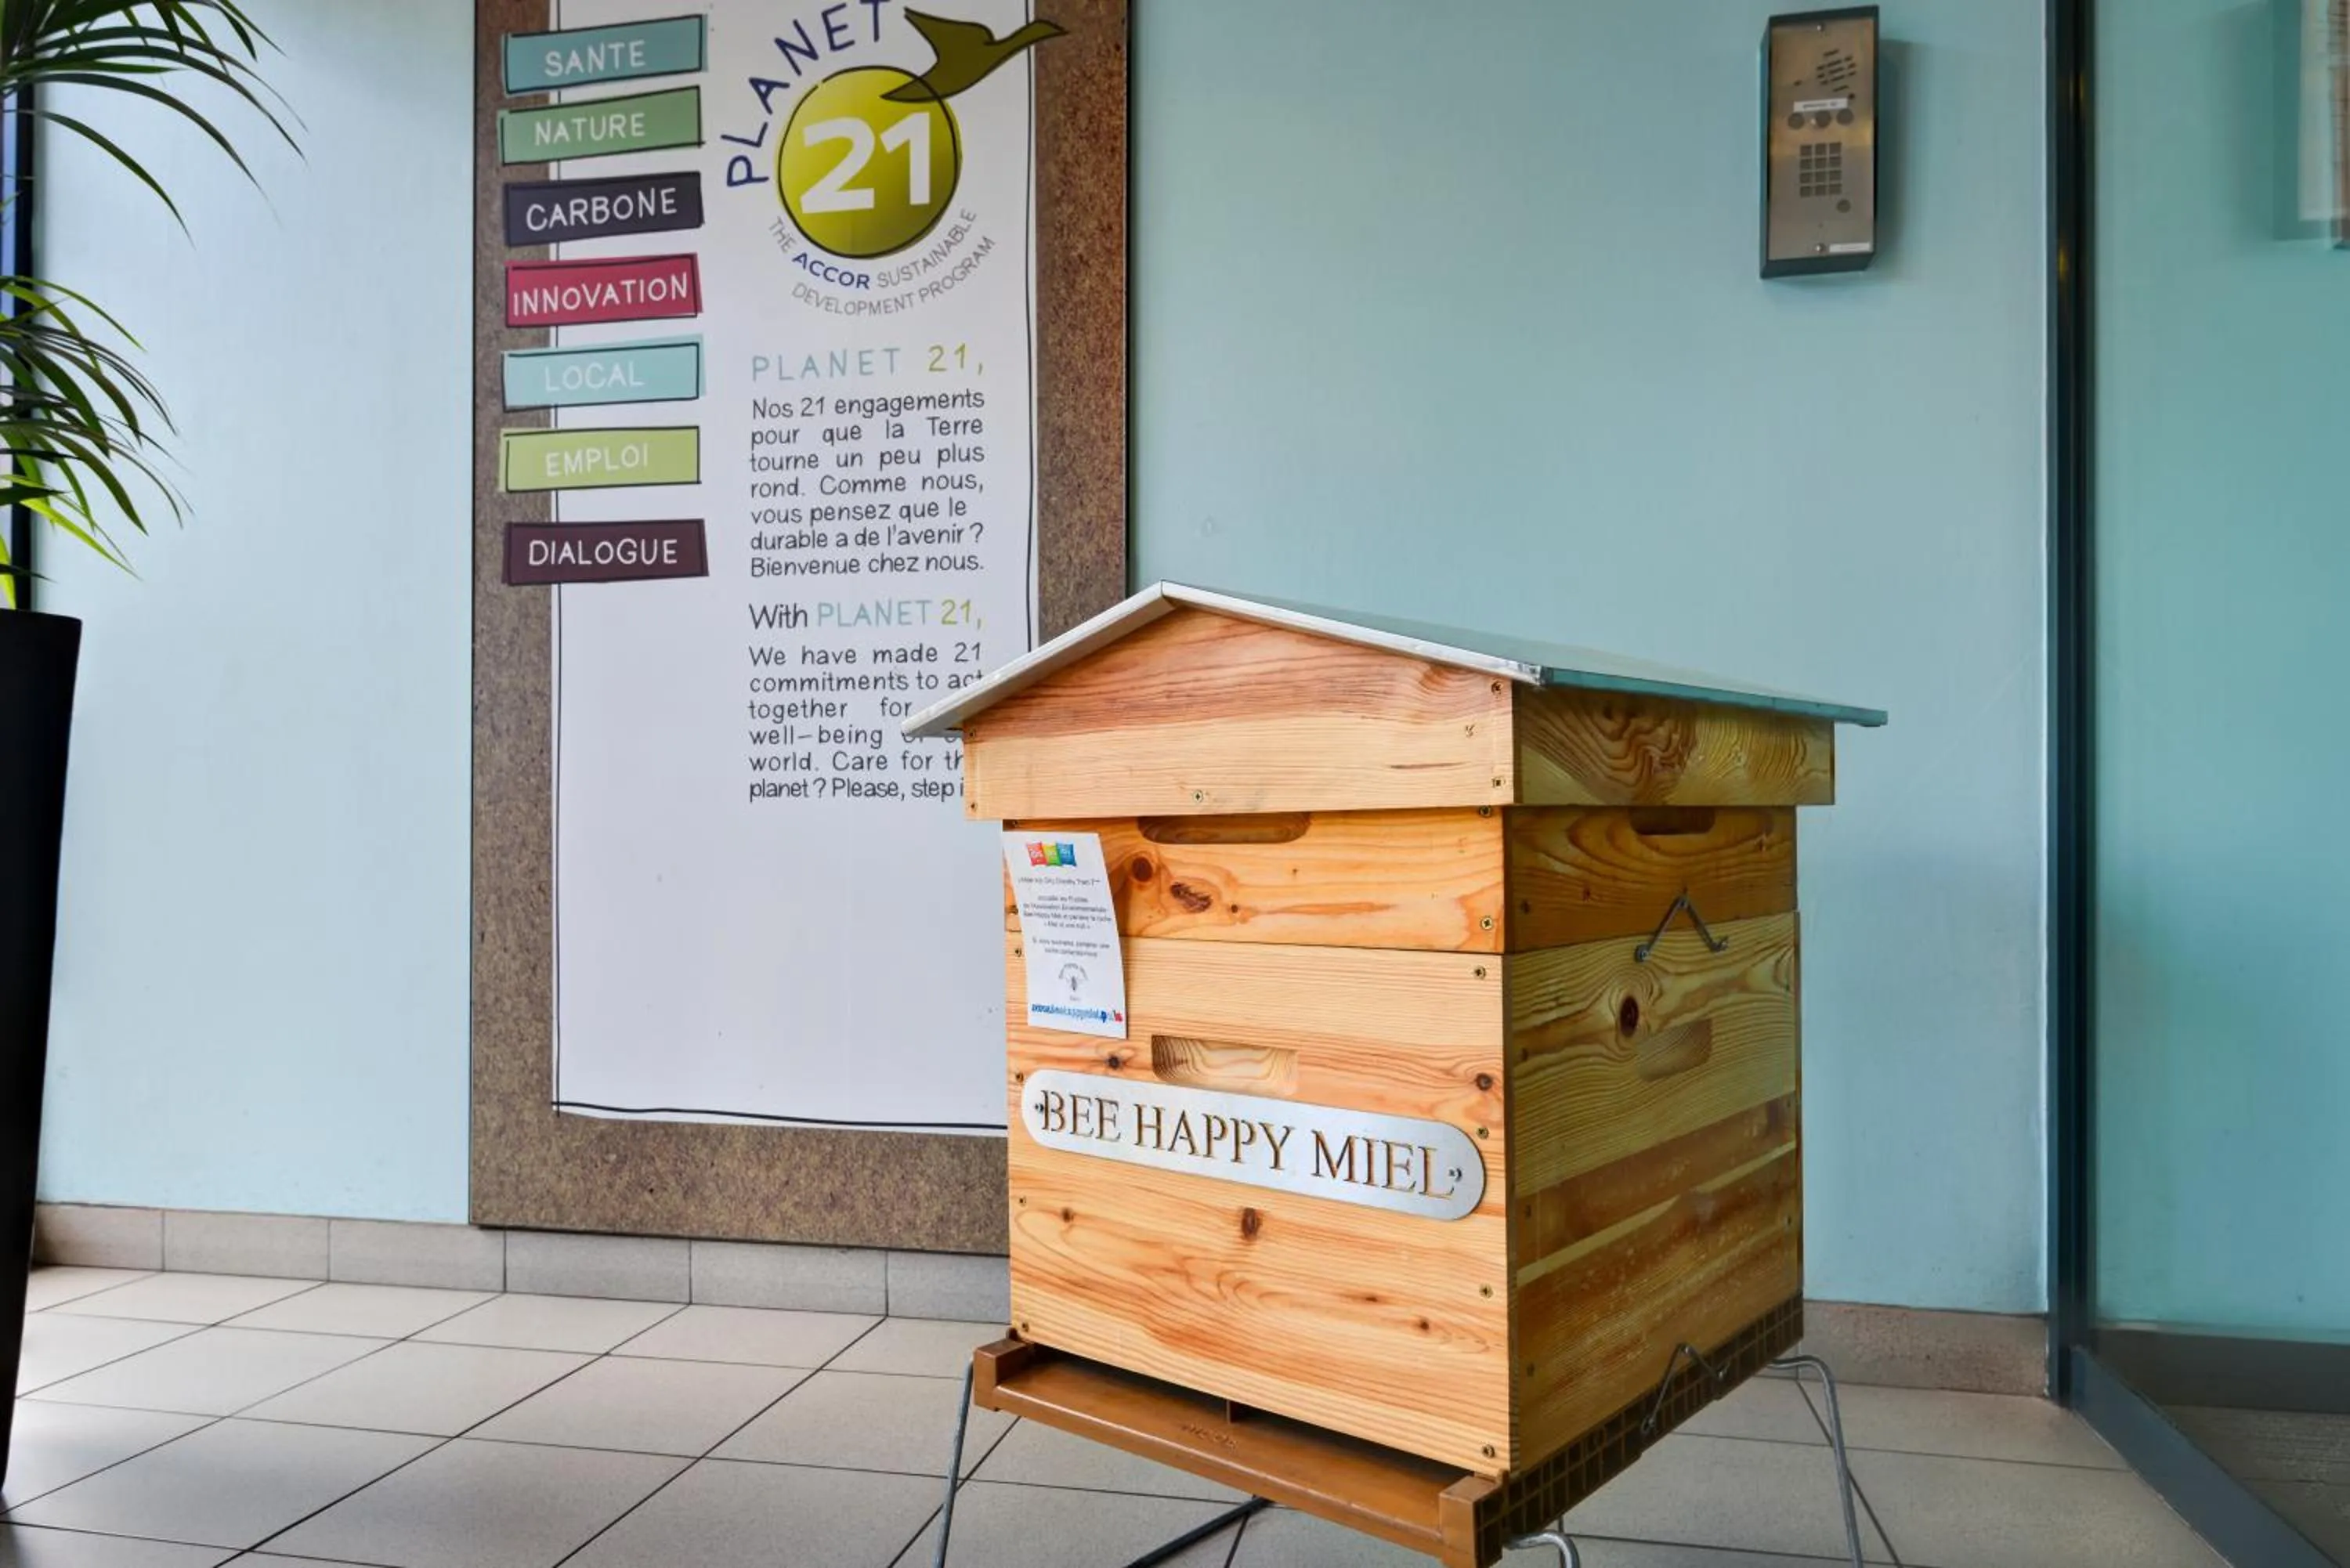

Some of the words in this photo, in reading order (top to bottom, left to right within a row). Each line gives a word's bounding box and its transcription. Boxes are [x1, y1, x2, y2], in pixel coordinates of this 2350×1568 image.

[544, 40, 646, 77] SANTE
[721, 0, 890, 186] PLANET
[534, 113, 645, 146] NATURE
[800, 111, 931, 214] 21
[526, 187, 677, 232] CARBONE
[768, 216, 797, 254] THE
[792, 252, 870, 289] ACCOR
[877, 208, 977, 289] SUSTAINABLE
[791, 281, 915, 316] DEVELOPMENT
[918, 237, 996, 303] PROGRAM
[513, 271, 687, 317] INNOVATION
[544, 361, 645, 392] LOCAL
[752, 348, 900, 381] PLANET
[927, 343, 984, 375] 21,
[752, 397, 794, 420] Nos
[801, 396, 825, 417] 21
[834, 388, 985, 419] engagements
[751, 428, 800, 450] pour
[822, 425, 862, 446] que
[886, 419, 905, 439] la
[926, 417, 984, 436] Terre
[546, 443, 649, 478] EMPLOI
[750, 453, 819, 471] tourne
[836, 451, 863, 468] un
[880, 449, 921, 471] peu
[938, 443, 985, 468] plus
[750, 477, 805, 498] rond.
[820, 475, 906, 496] Comme
[921, 473, 984, 493] nous,
[750, 508, 802, 524] vous
[810, 503, 891, 526] pensez
[898, 501, 939, 523] que
[949, 497, 967, 517] le
[529, 538, 678, 565] DIALOGUE
[750, 529, 828, 550] durable
[836, 533, 848, 547] a
[855, 527, 880, 546] de
[887, 524, 964, 547] l'avenir
[969, 522, 984, 544] ?
[750, 557, 861, 578] Bienvenue
[868, 552, 920, 573] chez
[925, 555, 984, 573] nous.
[749, 602, 808, 630] With
[817, 599, 933, 627] PLANET
[941, 598, 983, 630] 21,
[749, 645, 786, 666] We
[801, 645, 857, 665] have
[873, 643, 938, 665] made
[953, 641, 981, 663] 21
[750, 670, 909, 693] commitments
[916, 670, 939, 690] to
[749, 698, 848, 724] together
[880, 697, 913, 717] for
[749, 751, 819, 771] world.
[832, 750, 888, 771] Care
[902, 750, 933, 770] for
[944, 751, 963, 771] th
[750, 779, 809, 803] planet
[813, 777, 826, 797] ?
[832, 777, 906, 800] Please,
[912, 778, 955, 803] step
[1040, 1089, 1122, 1143] BEE
[1133, 1103, 1295, 1170] HAPPY
[1311, 1129, 1455, 1199] MIEL
